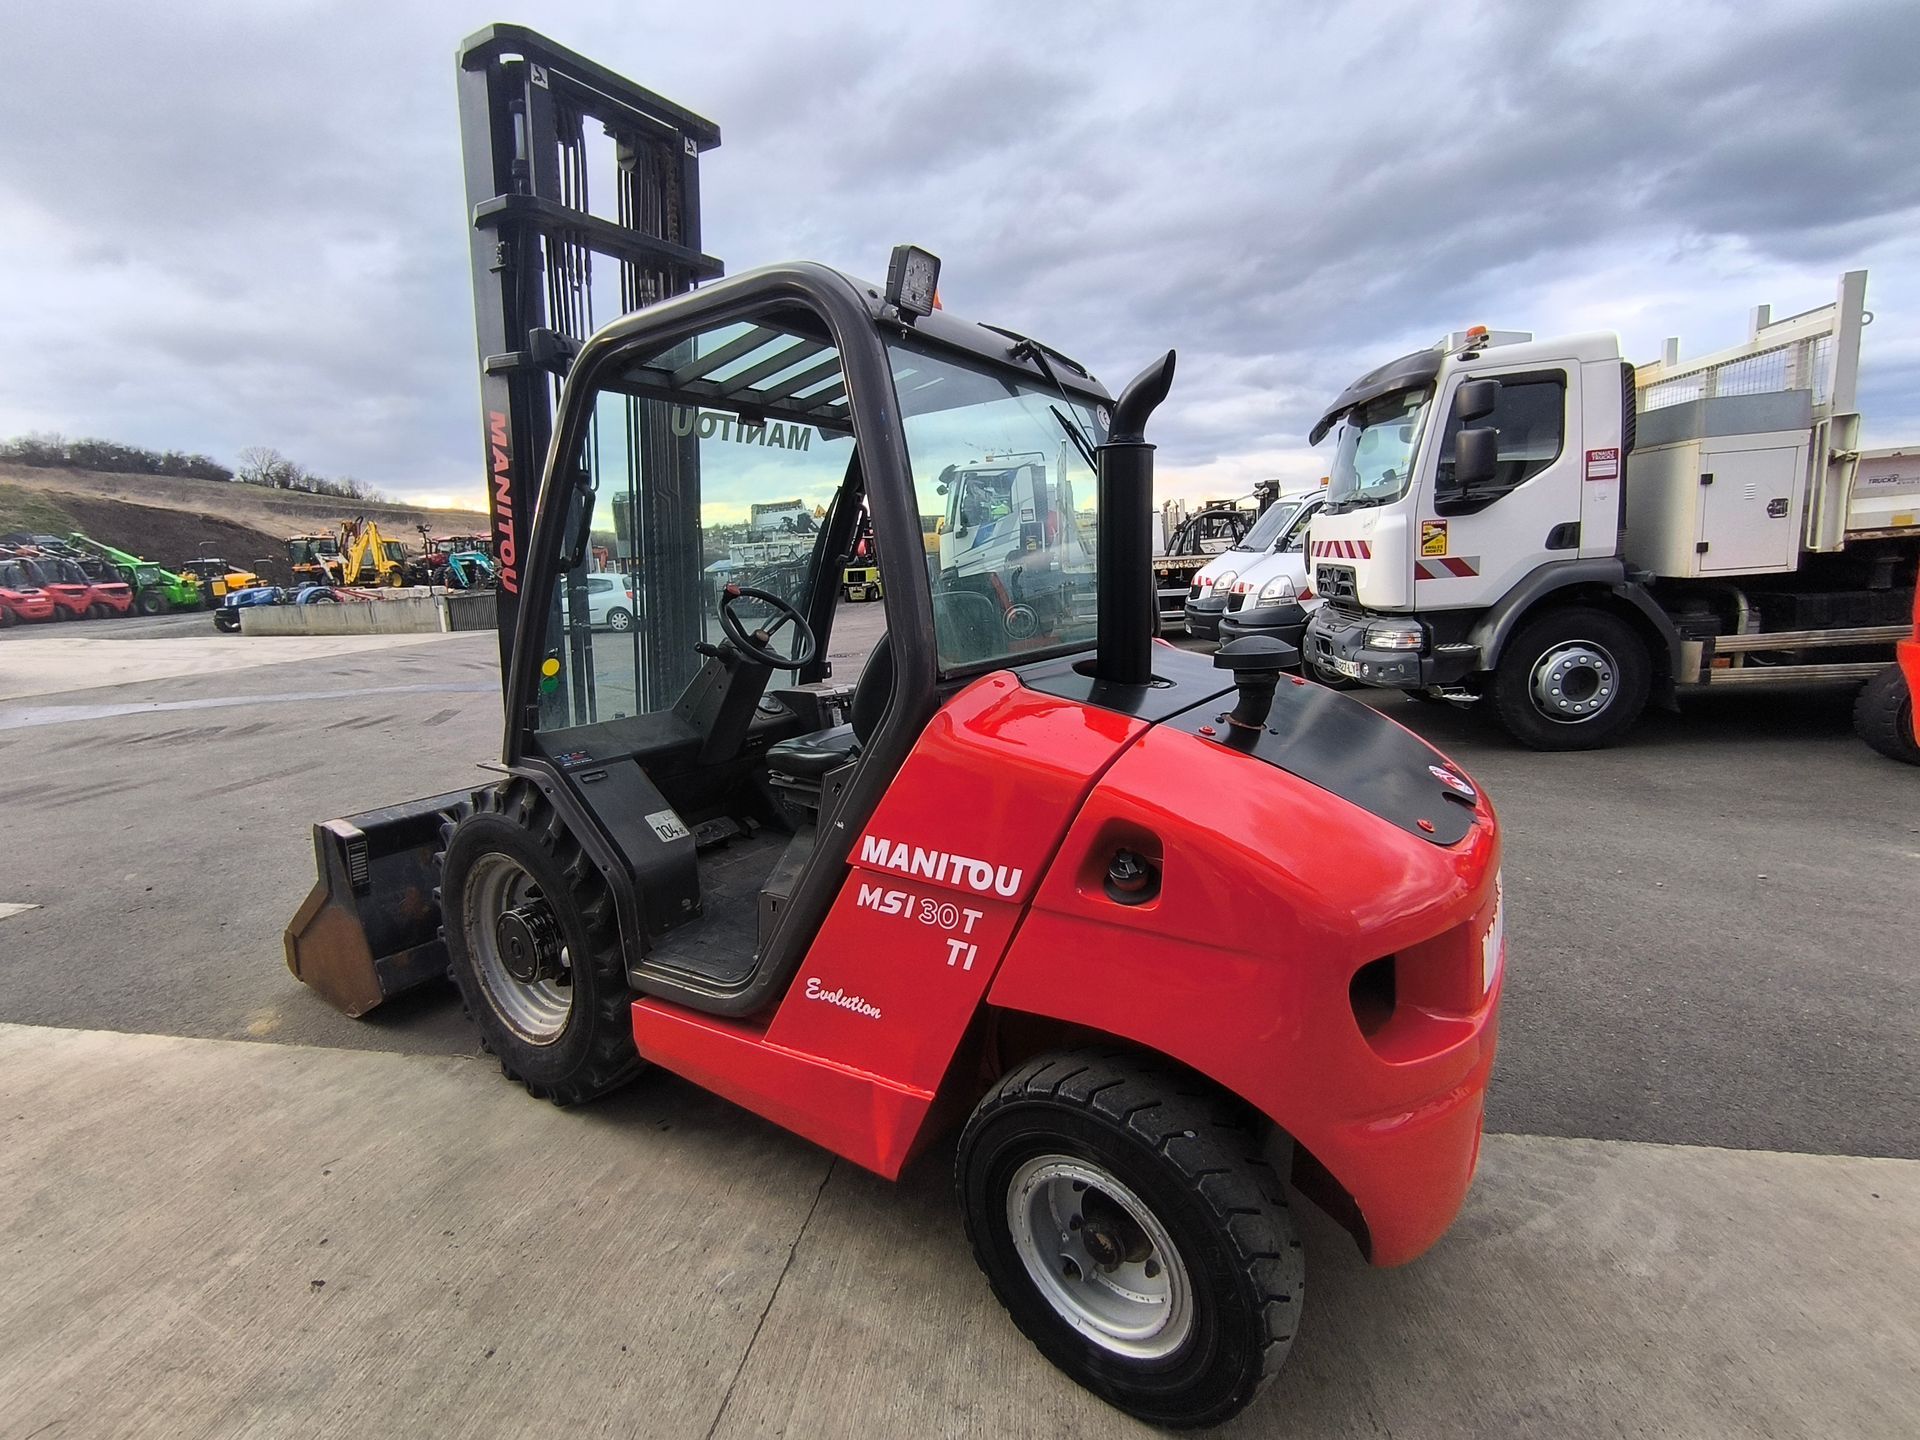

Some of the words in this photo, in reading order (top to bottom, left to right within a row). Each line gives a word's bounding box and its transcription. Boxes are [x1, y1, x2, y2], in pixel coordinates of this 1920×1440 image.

[490, 411, 517, 593] MANITOU
[655, 823, 680, 840] 104
[860, 834, 1023, 897] MANITOU
[856, 883, 916, 919] MSI
[918, 898, 959, 930] 30
[962, 908, 984, 934] T
[946, 938, 978, 971] TI
[805, 977, 882, 1019] Evolution
